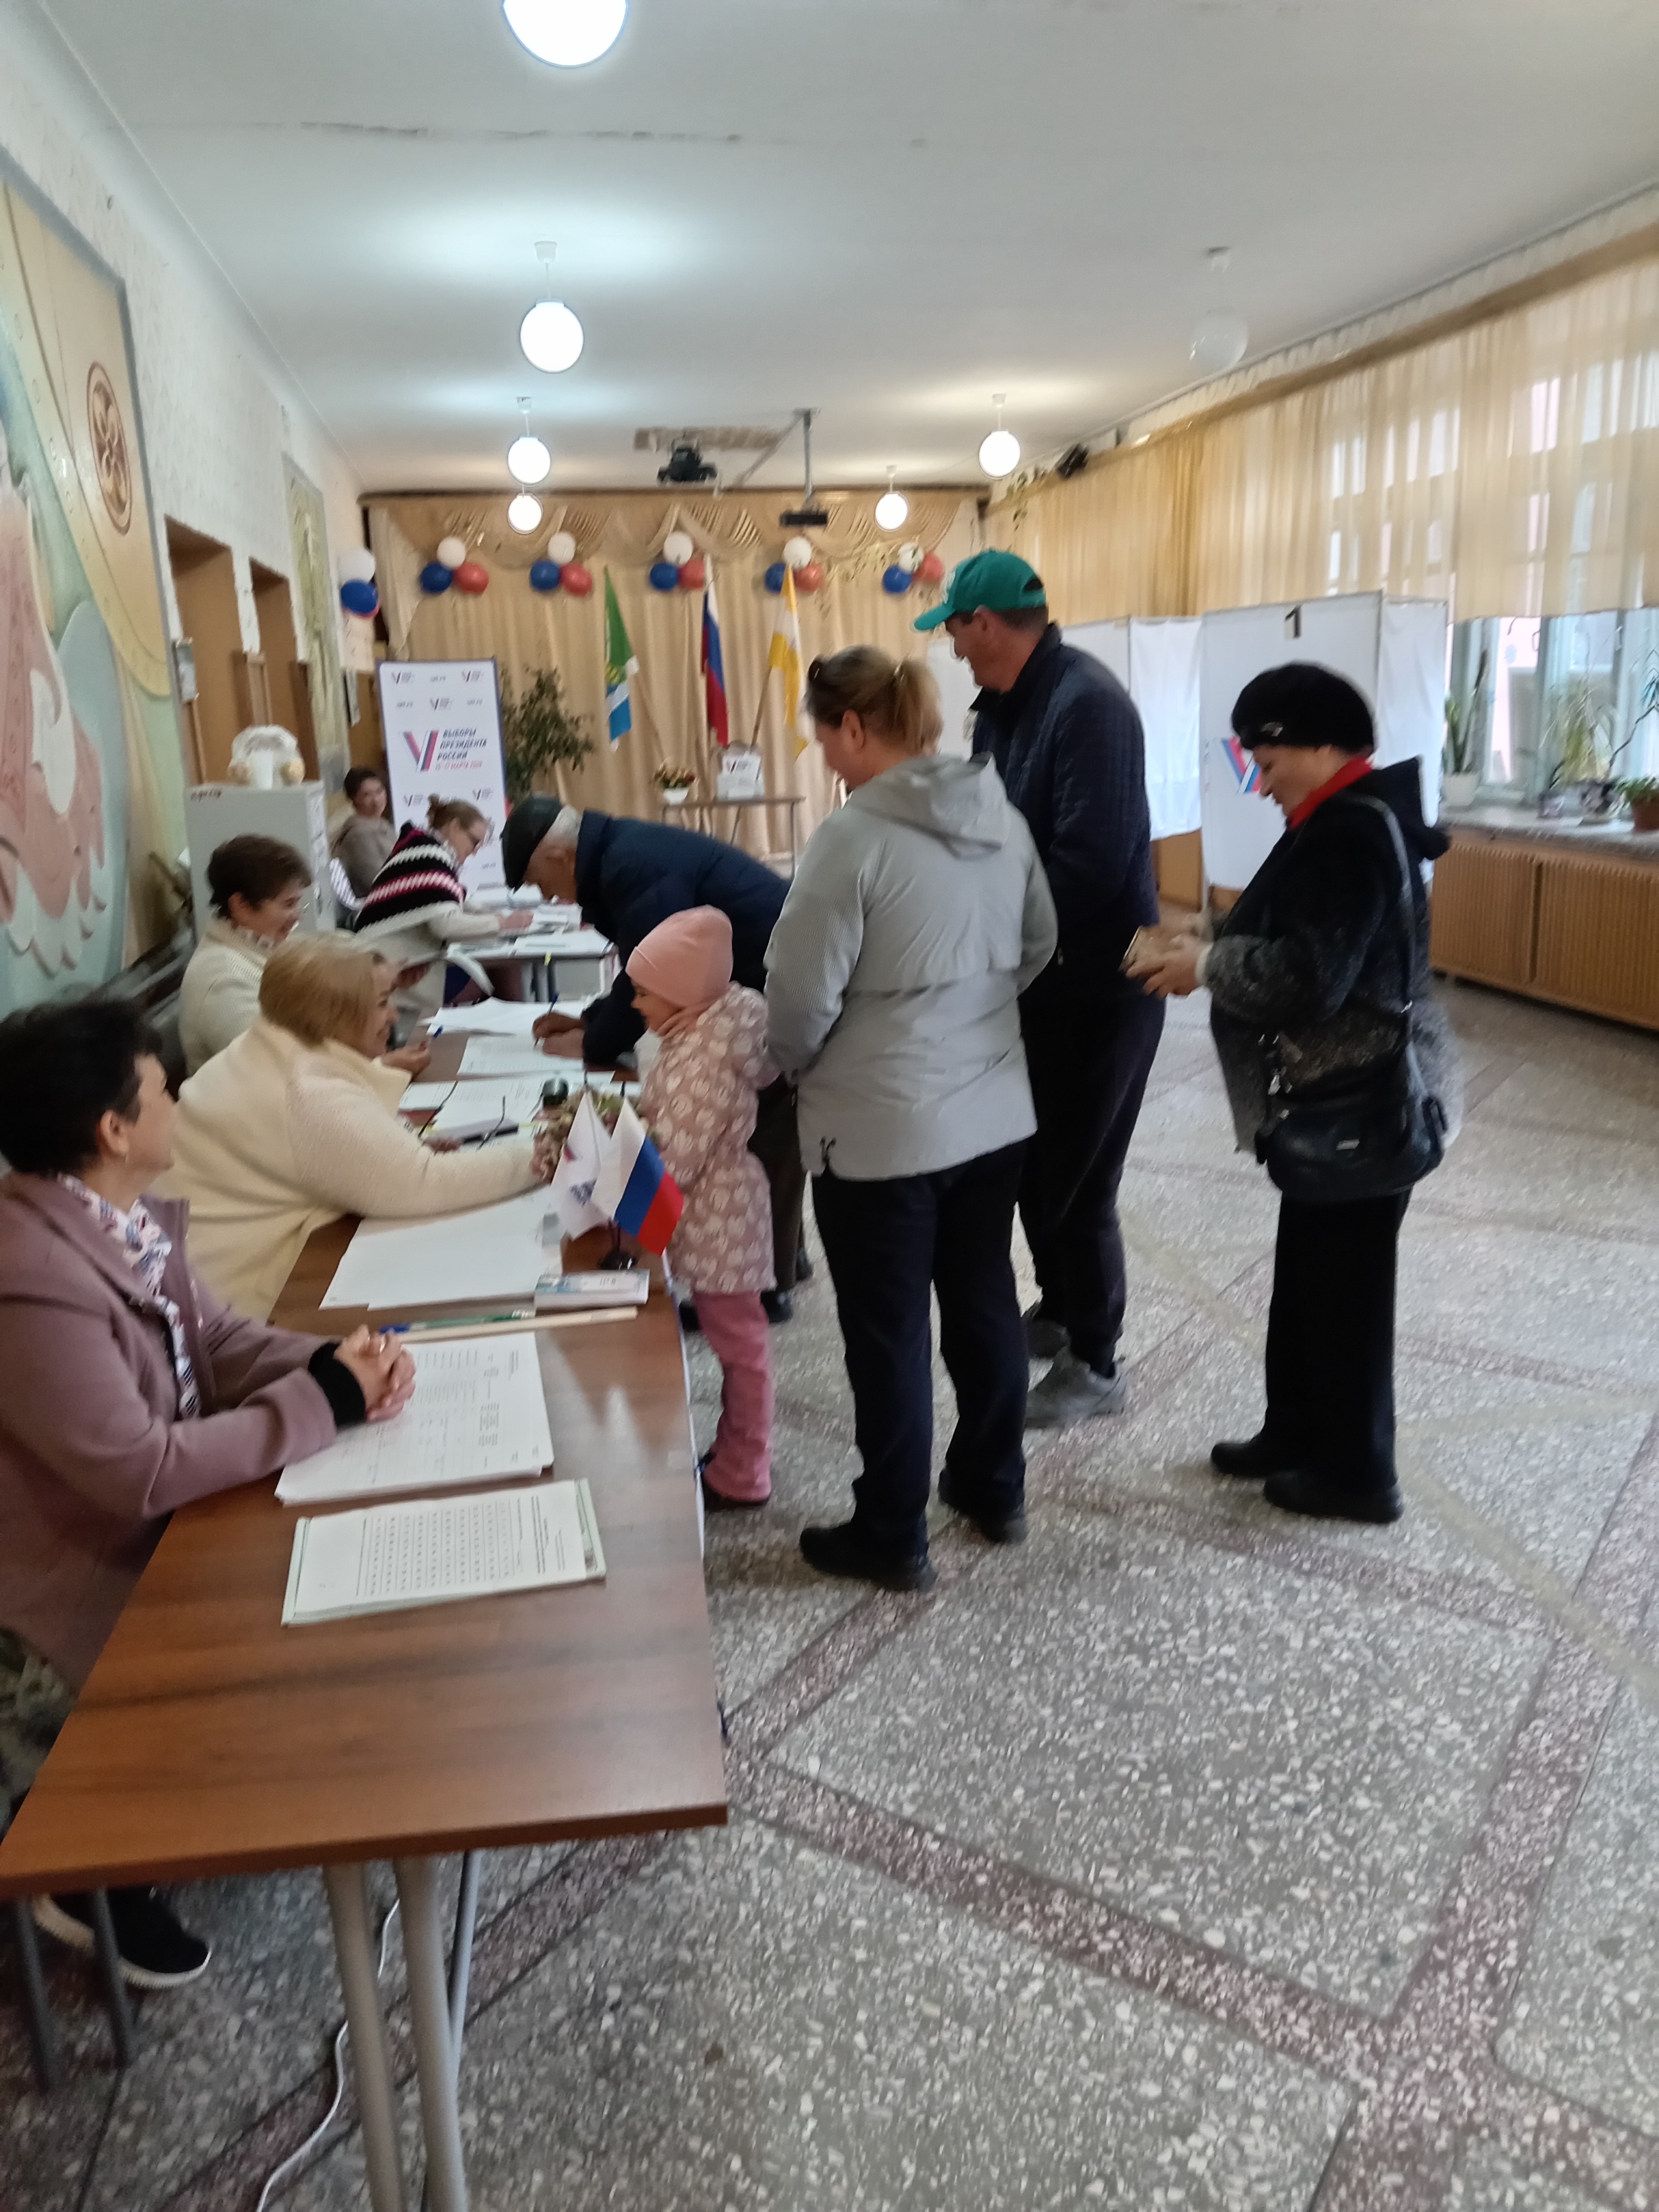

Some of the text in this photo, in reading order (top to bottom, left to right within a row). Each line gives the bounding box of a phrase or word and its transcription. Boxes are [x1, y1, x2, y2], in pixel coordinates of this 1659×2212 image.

[1285, 605, 1301, 638] 1
[443, 729, 476, 738] ВЫБОРЫ
[440, 739, 487, 750] ПРЕЗИДЕНТА
[437, 751, 468, 760] РОССИИ
